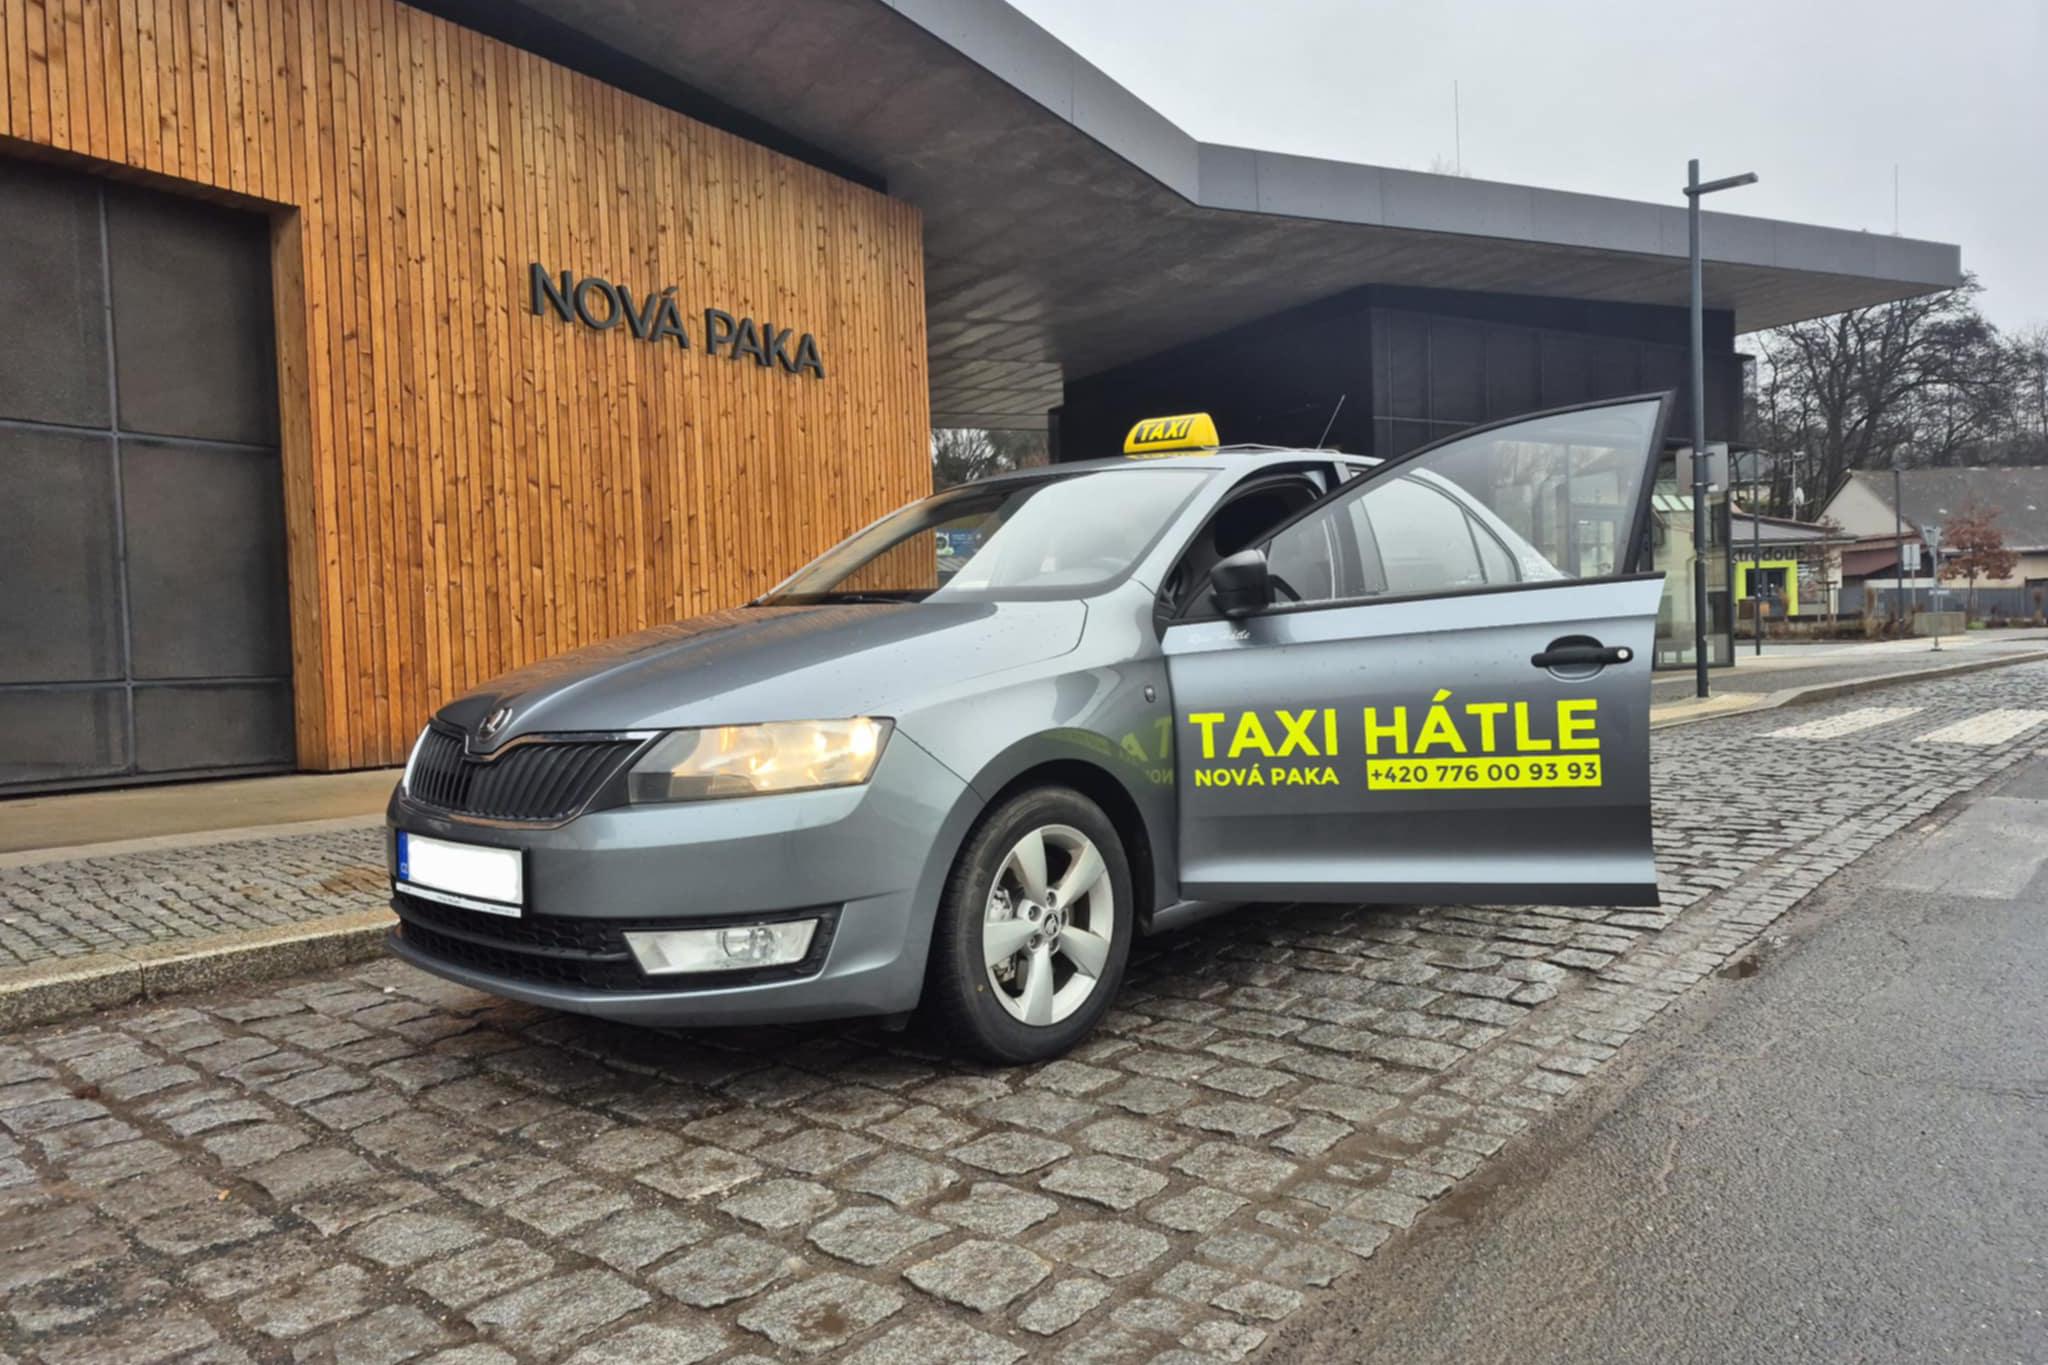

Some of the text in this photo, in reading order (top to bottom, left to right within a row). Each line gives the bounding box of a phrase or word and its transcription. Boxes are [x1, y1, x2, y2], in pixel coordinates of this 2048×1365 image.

[529, 261, 825, 379] NOVÁ PAKA
[1138, 417, 1193, 442] TAXI
[1188, 708, 1339, 760] TAXI
[1363, 688, 1600, 755] HÁTLE
[1194, 762, 1265, 787] NOVÁ
[1270, 766, 1340, 786] PAKA
[1371, 761, 1598, 783] +420 776 00 93 93
